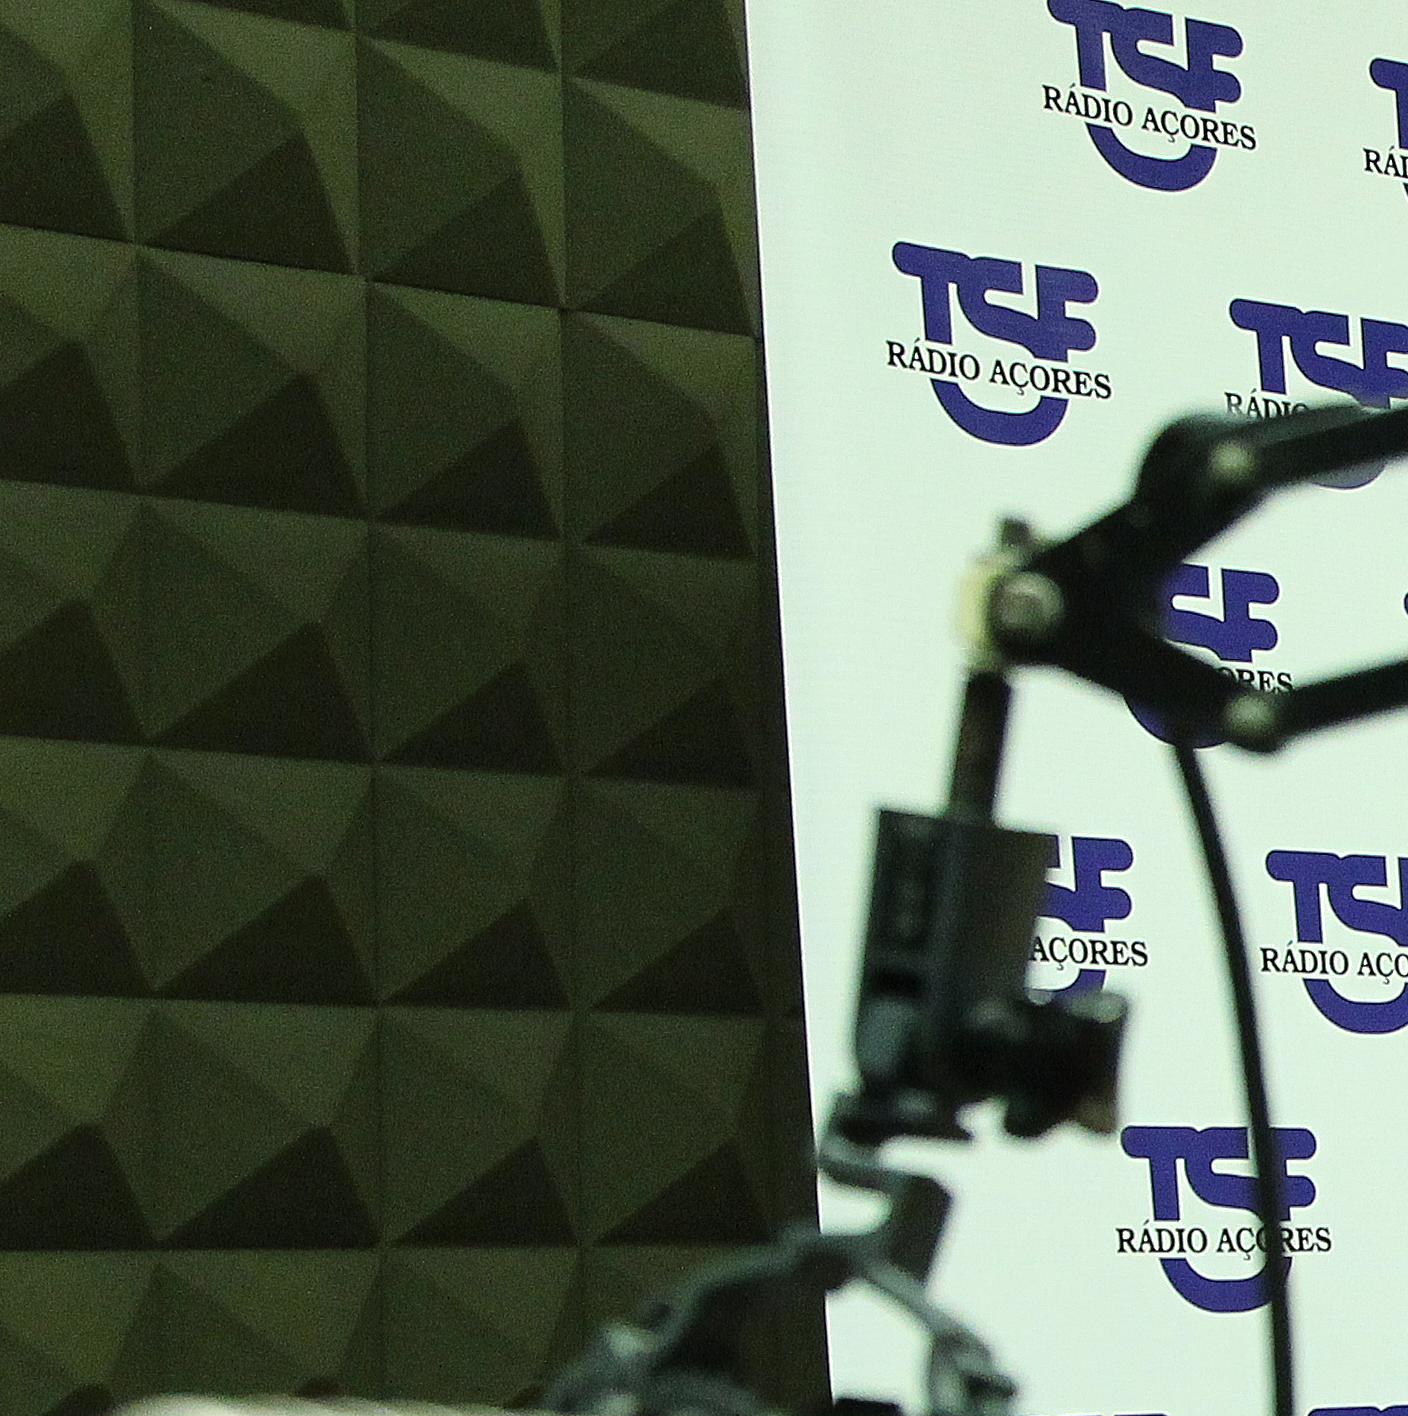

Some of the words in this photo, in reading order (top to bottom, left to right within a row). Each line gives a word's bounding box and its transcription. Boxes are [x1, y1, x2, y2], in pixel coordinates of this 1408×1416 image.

[1042, 83, 1134, 127] RÁDIO
[1140, 107, 1257, 151] AÇORES
[886, 338, 981, 381] RÁDIO
[989, 360, 1112, 400] AÇORES
[1029, 936, 1149, 971] AÇORES
[1259, 941, 1350, 976] RÁDIO
[1115, 1219, 1208, 1254] RÁDIO
